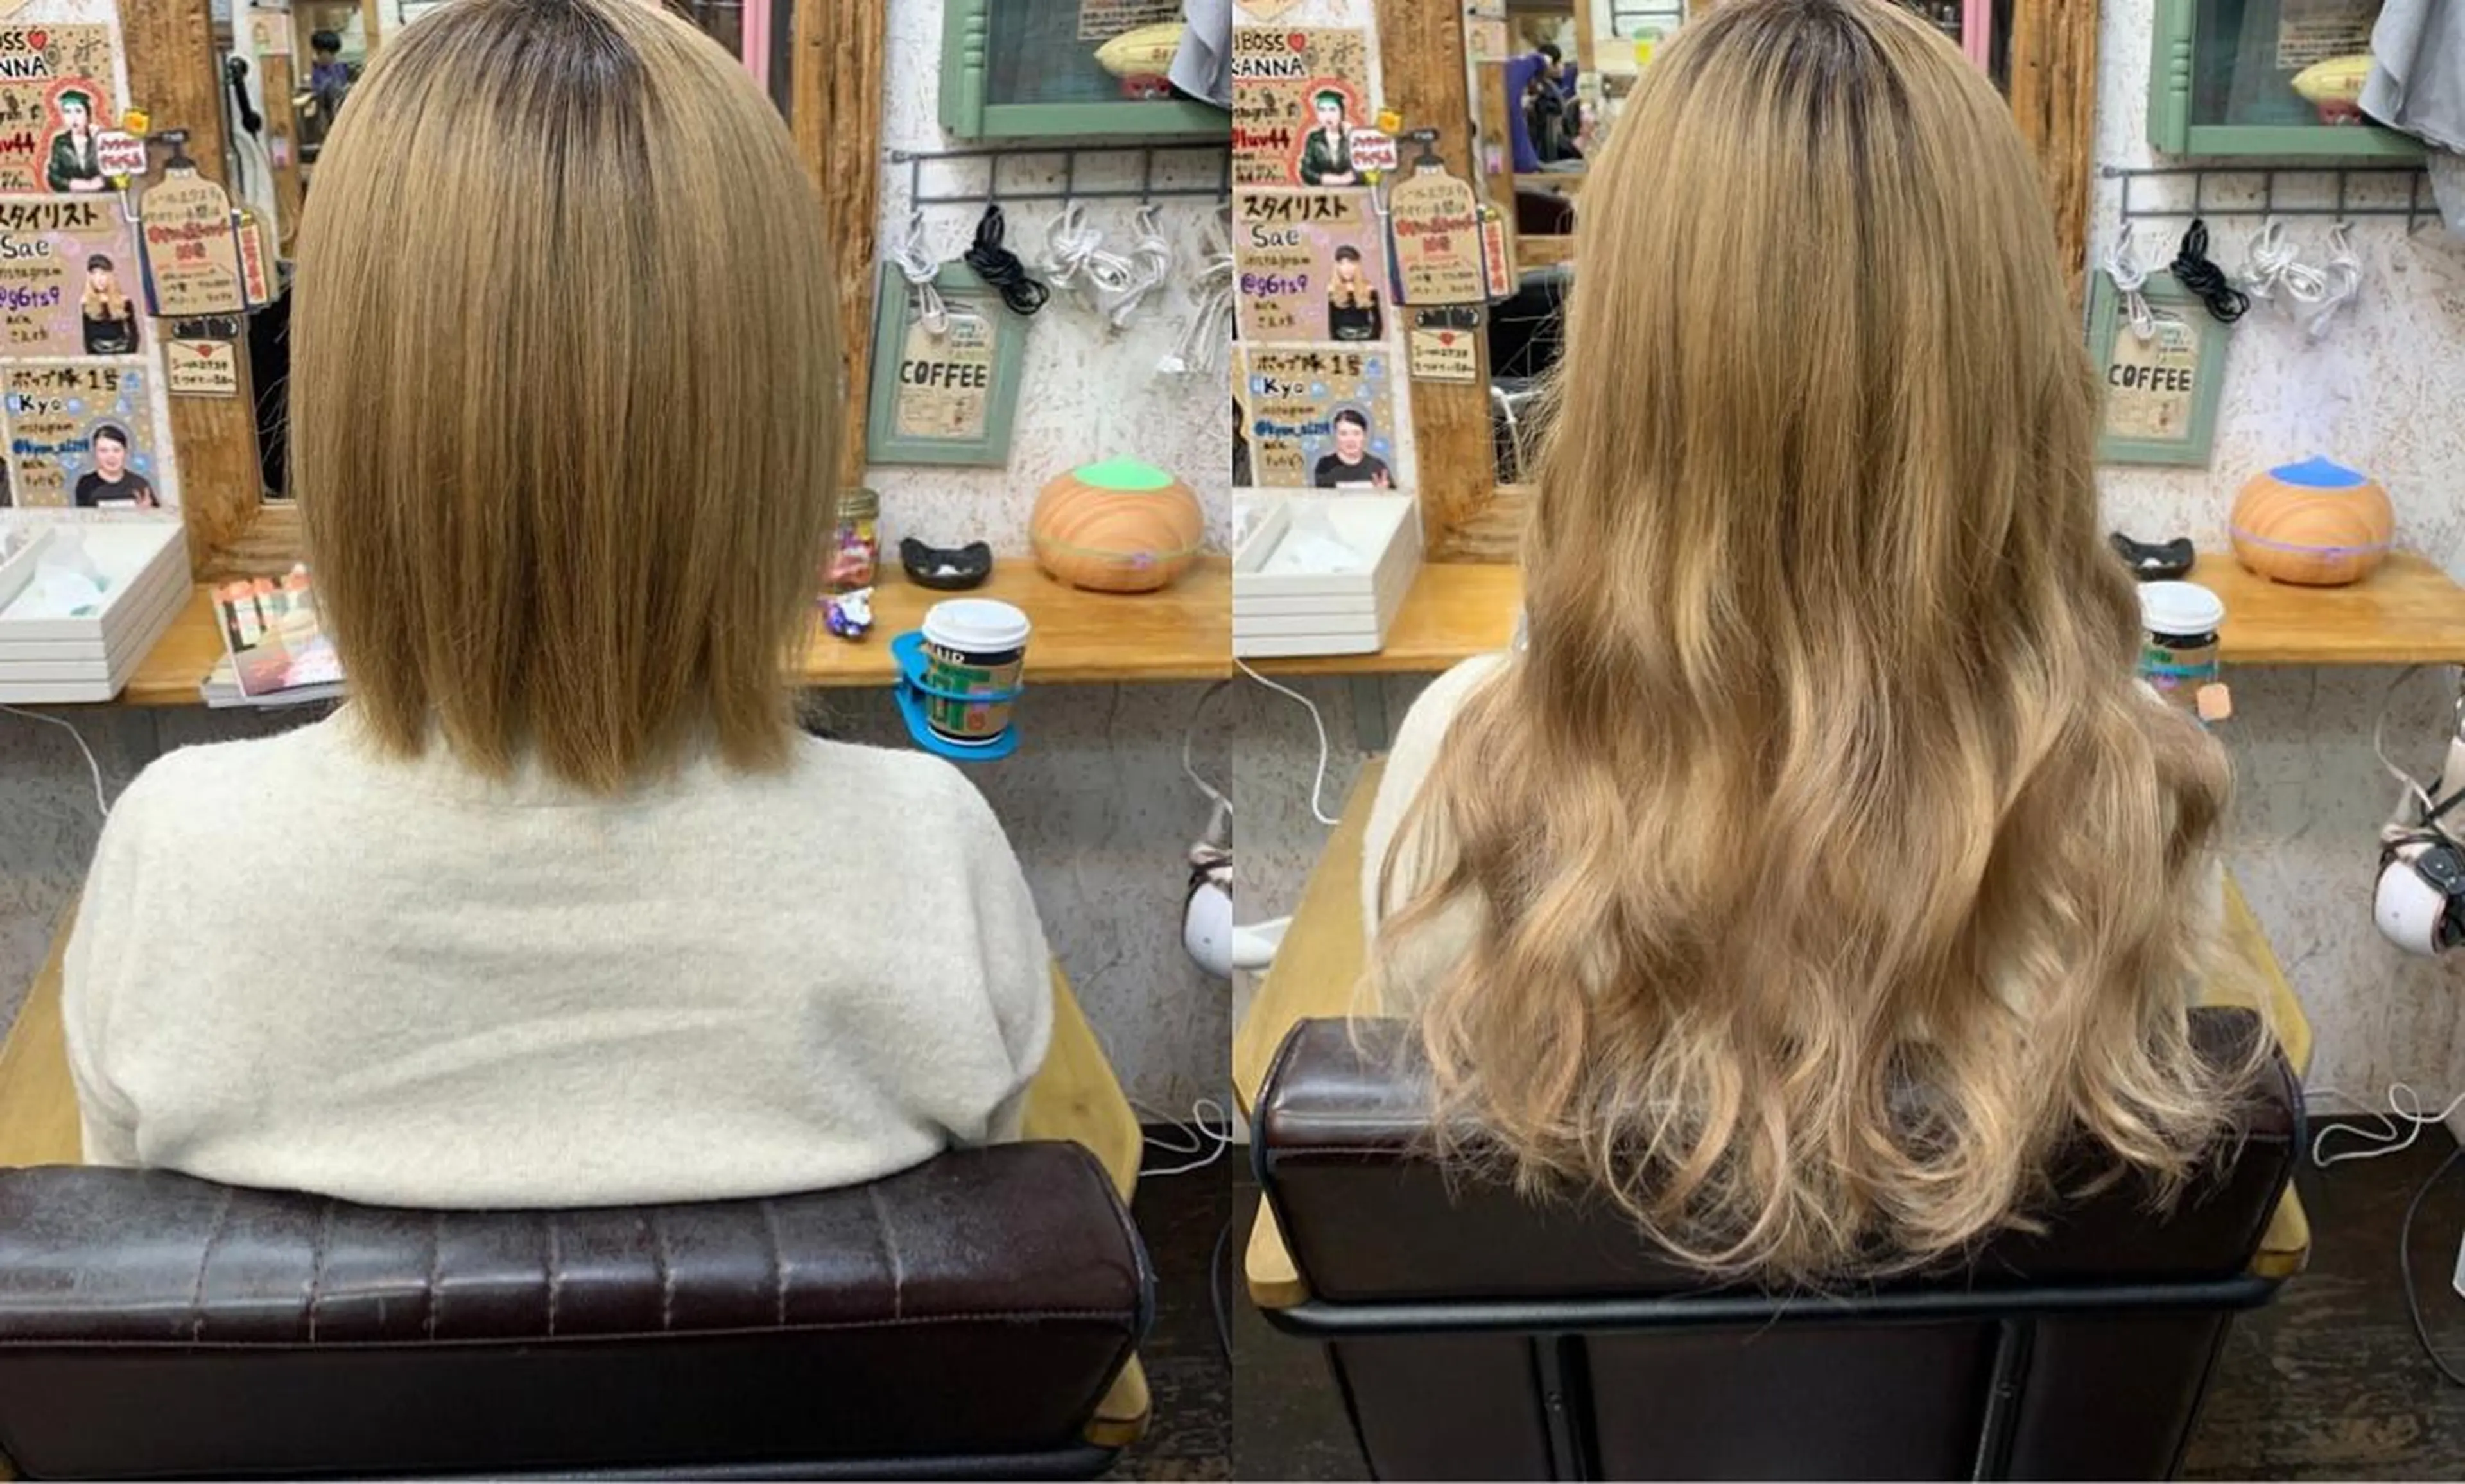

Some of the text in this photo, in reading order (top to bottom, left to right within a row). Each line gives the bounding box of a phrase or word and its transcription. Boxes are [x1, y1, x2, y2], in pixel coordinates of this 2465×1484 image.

[1243, 194, 1349, 221] スタイリスト
[1, 234, 49, 259] Sae
[1252, 225, 1299, 248] Sae
[900, 360, 987, 389] COFFEE
[2108, 364, 2191, 392] COFFEE
[1263, 377, 1304, 399] Kyo
[20, 393, 61, 415] Kyo
